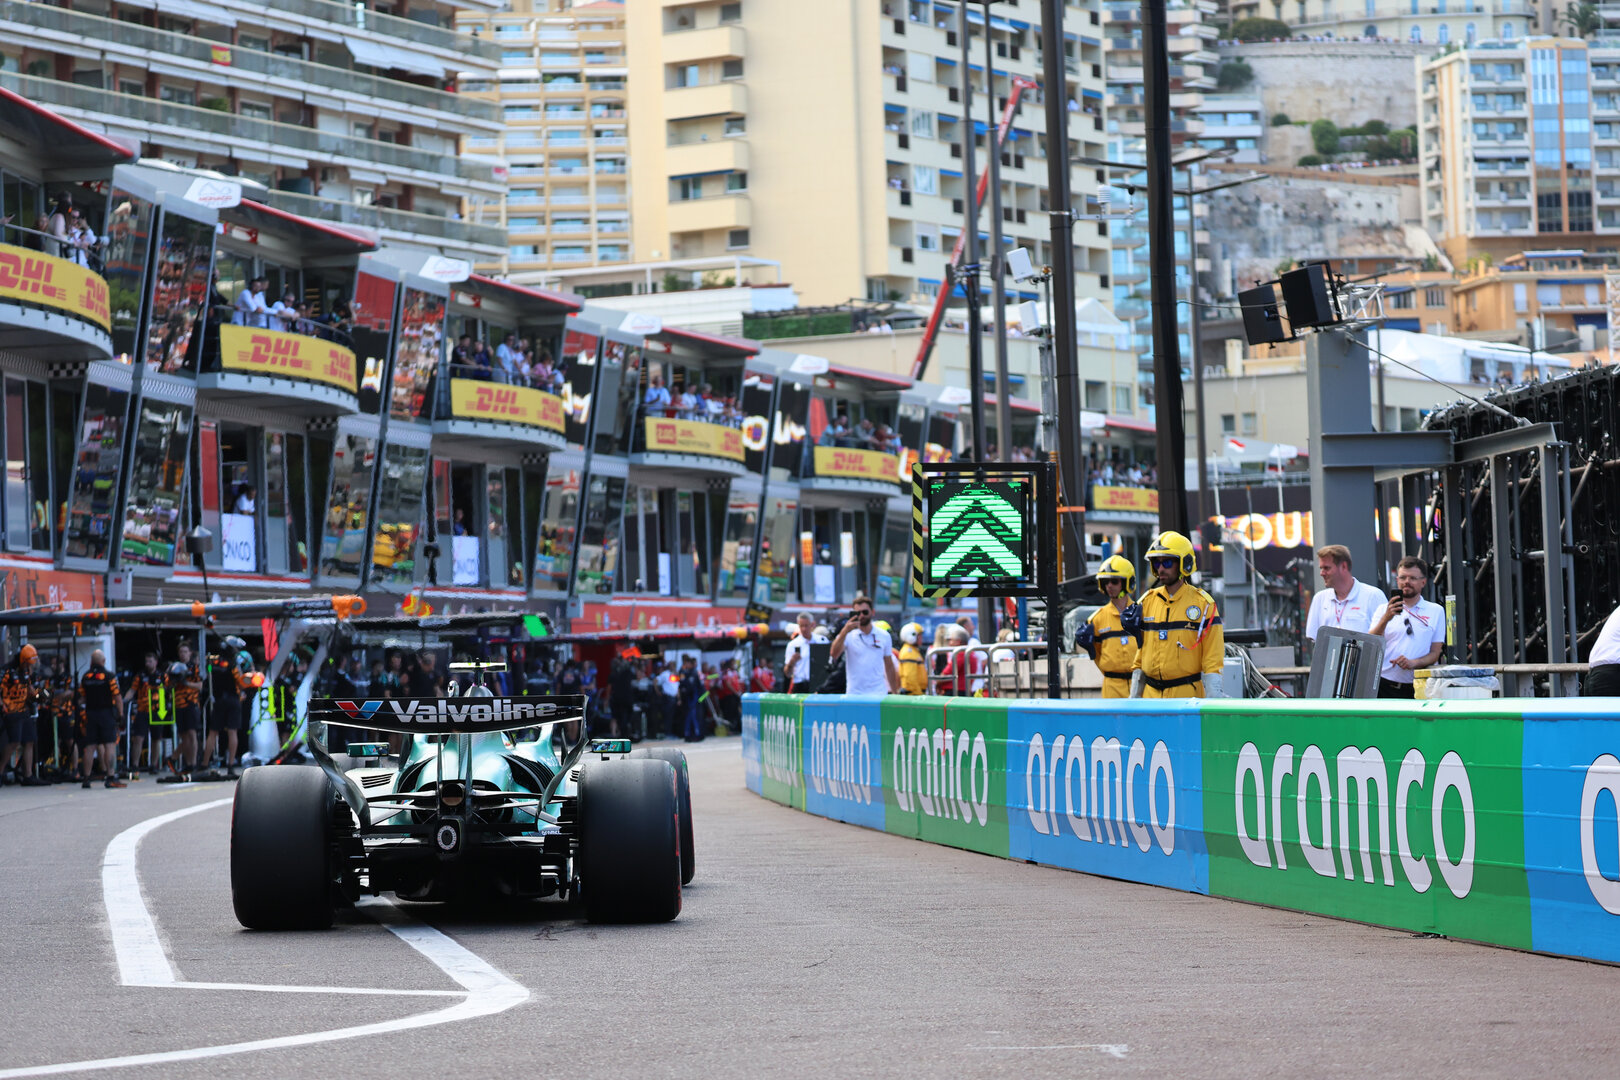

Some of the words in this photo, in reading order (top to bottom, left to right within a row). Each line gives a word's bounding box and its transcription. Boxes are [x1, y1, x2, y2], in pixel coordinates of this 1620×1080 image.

[0, 251, 57, 298] DHL
[85, 277, 108, 320] DHL
[250, 334, 304, 369] DHL
[329, 349, 354, 383] DHL
[476, 386, 520, 415] DHL
[833, 452, 867, 473] DHL
[388, 698, 558, 724] Valvoline
[811, 719, 871, 806] aramco
[893, 726, 989, 827] aramco
[1026, 732, 1176, 857] aramco
[1234, 741, 1476, 900] aramco
